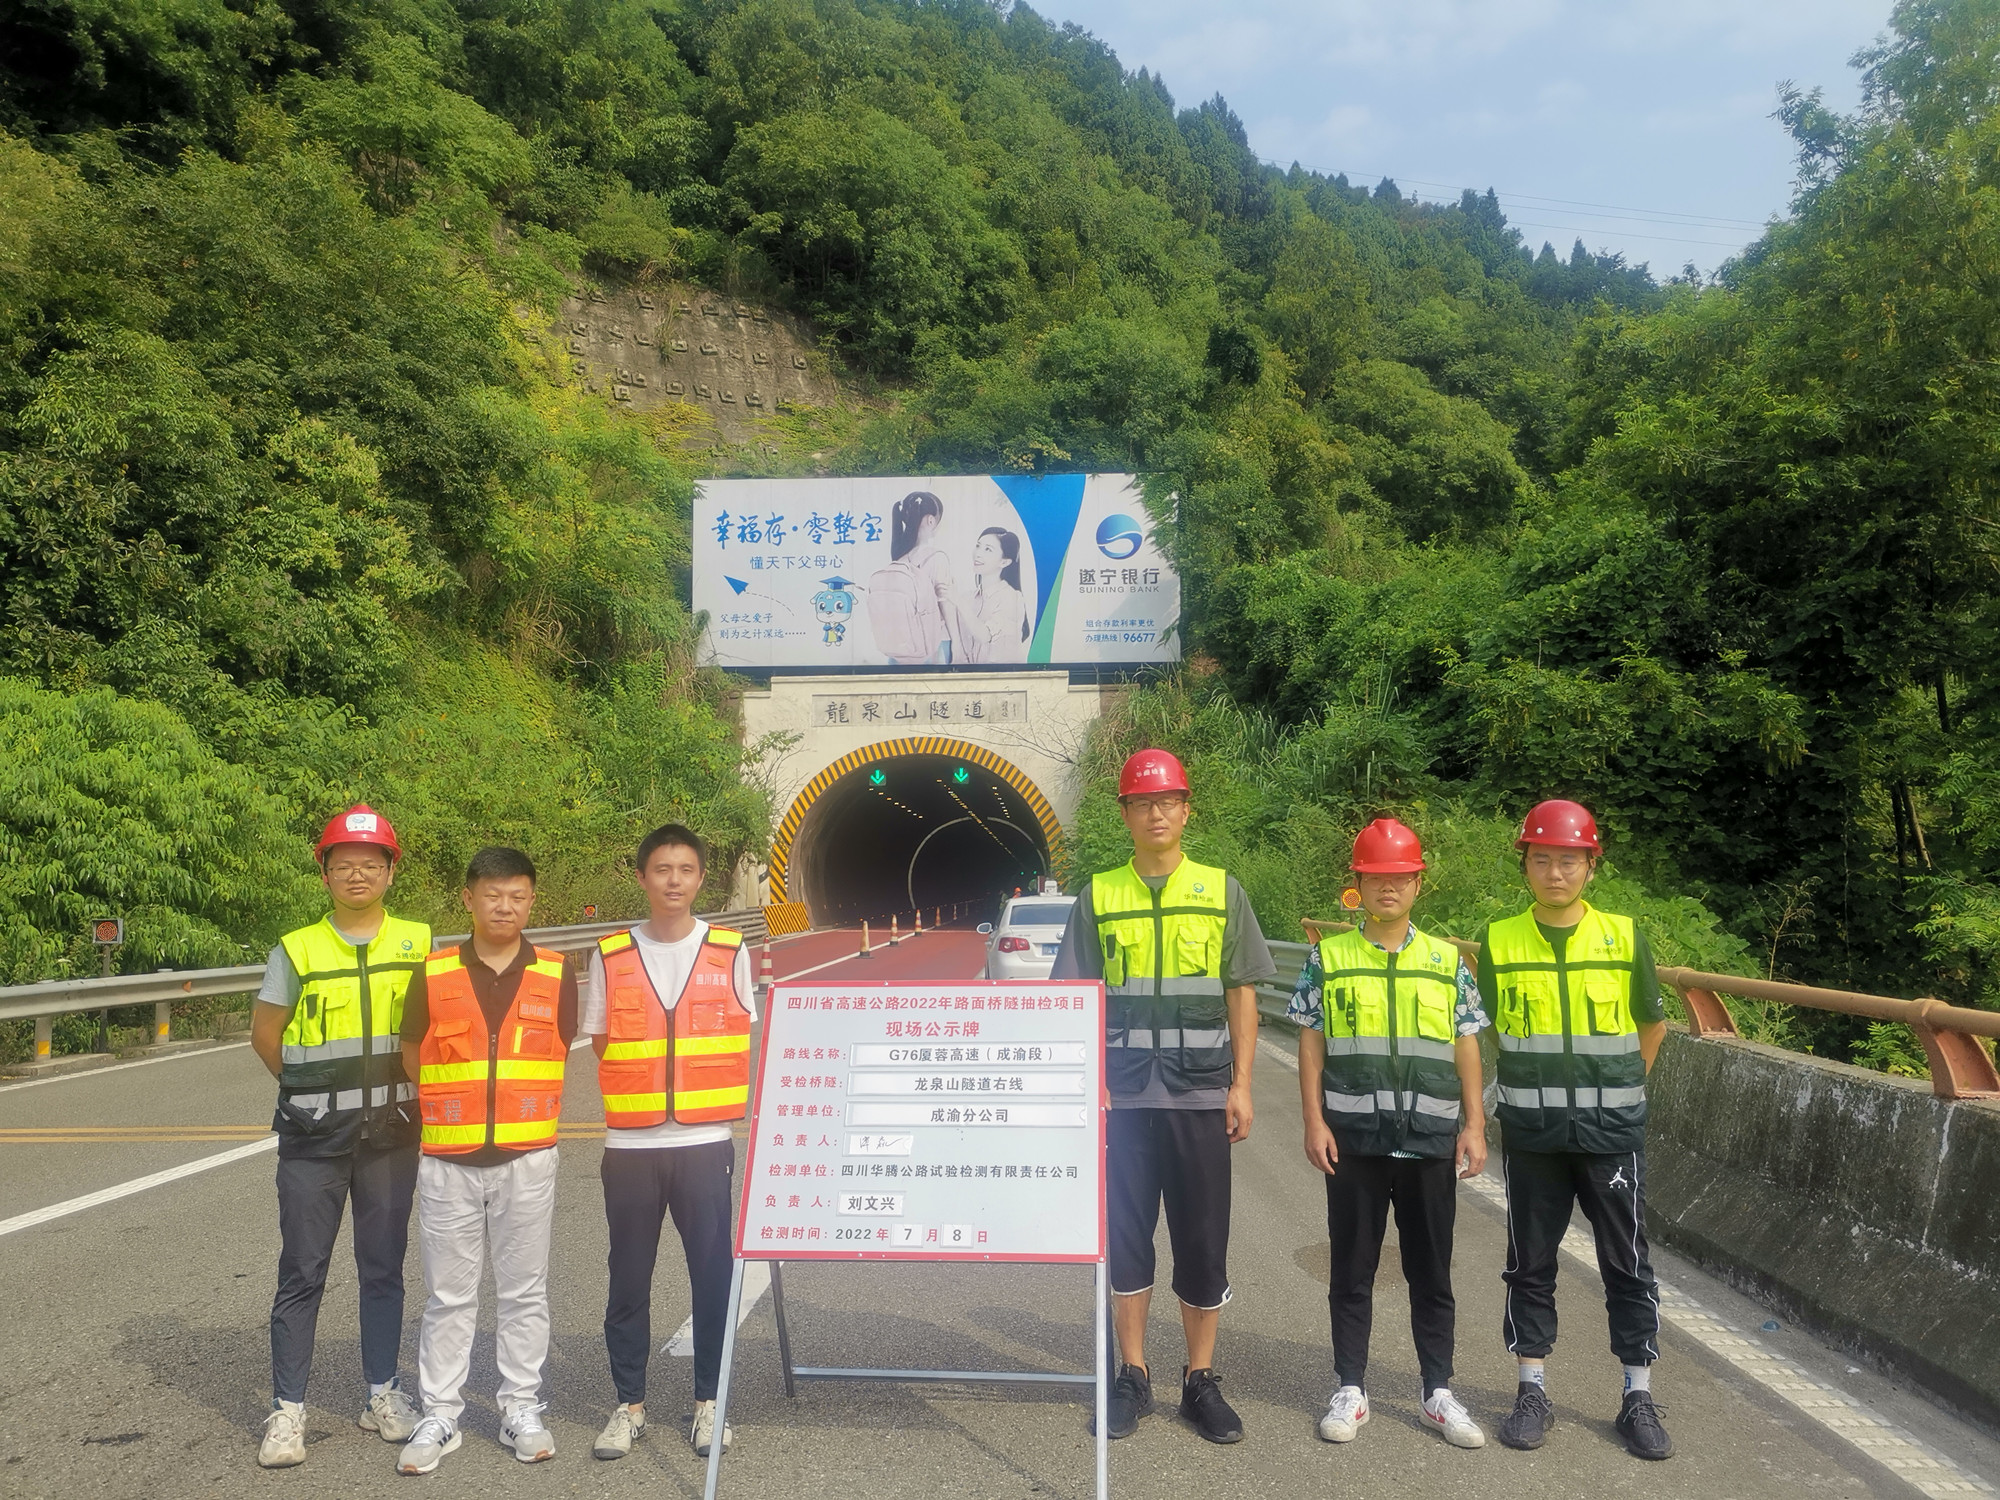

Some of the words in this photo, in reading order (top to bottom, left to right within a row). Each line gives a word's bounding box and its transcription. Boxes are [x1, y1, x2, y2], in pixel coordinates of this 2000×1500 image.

[711, 509, 883, 549] 幸福存·零整宝
[750, 555, 844, 570] 懂天下父母心
[1079, 568, 1160, 585] 遂宁银行
[1079, 586, 1125, 594] SUINING
[1130, 585, 1160, 593] BANK
[720, 612, 773, 624] 父母之爱子
[1123, 632, 1156, 643] 96677
[824, 700, 985, 724] 龍泉山隧道
[787, 996, 1084, 1010] 四川省高速公路2022年路面桥隧抽检项目
[885, 1021, 980, 1037] 现场公示牌
[914, 1077, 1024, 1091] 龙泉山隧道右线
[930, 1108, 1009, 1123] 成渝分公司
[841, 1164, 1078, 1178] 四川华腾公路试验检测有限责任公司
[848, 1196, 895, 1211] 刘文兴
